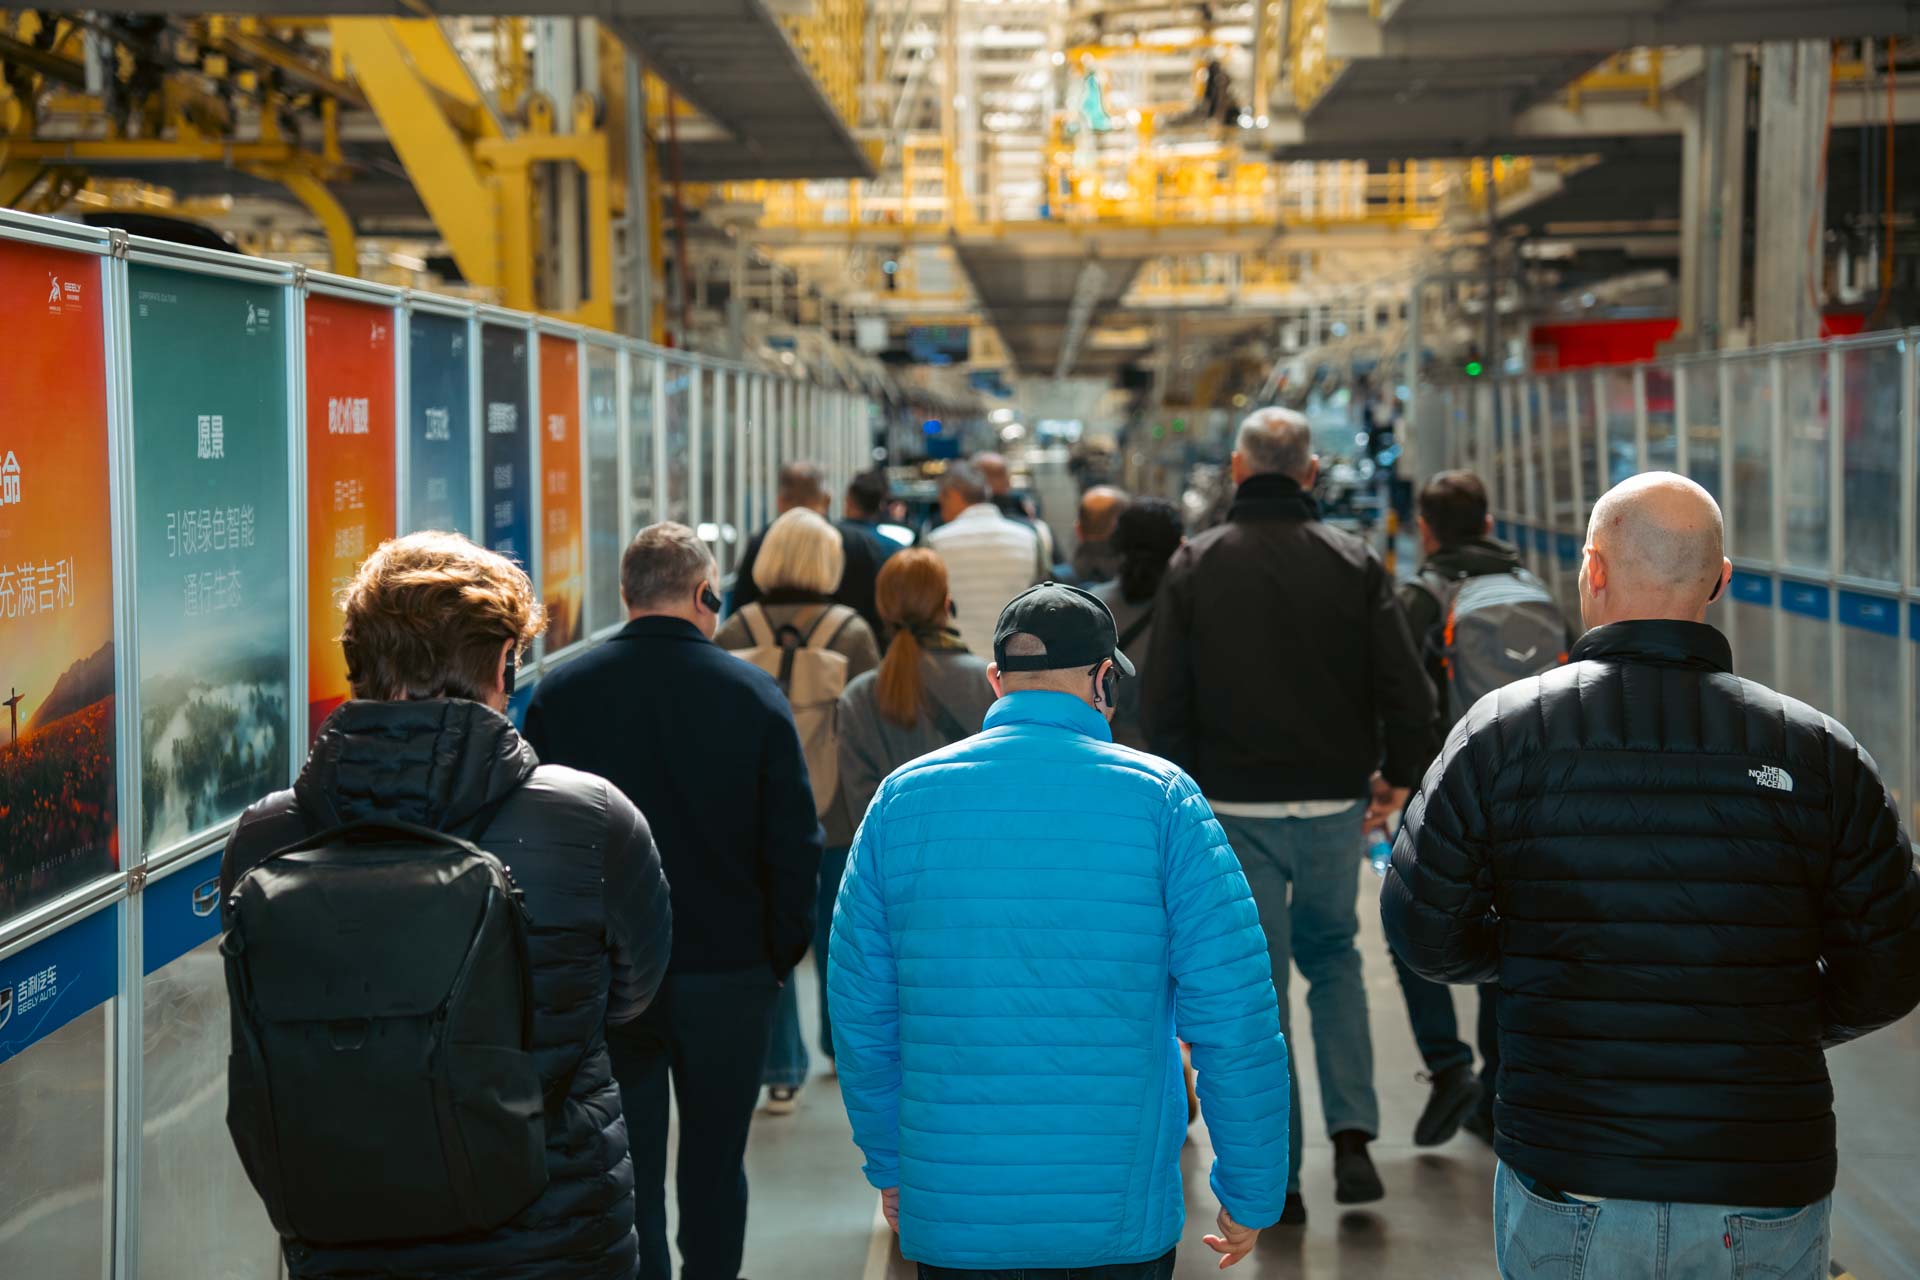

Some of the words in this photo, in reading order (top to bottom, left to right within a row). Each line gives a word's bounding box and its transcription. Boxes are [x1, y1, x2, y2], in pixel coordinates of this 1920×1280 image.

[198, 415, 224, 459] 愿景
[0, 450, 21, 506] 命
[166, 504, 255, 557] 引领绿色智能
[0, 556, 75, 618] 充满吉利
[1748, 769, 1779, 781] NORTH
[1756, 777, 1779, 789] FACE
[1762, 764, 1779, 774] THE
[18, 965, 57, 1003] 吉利汽车
[18, 995, 39, 1015] GEELY
[39, 985, 57, 1003] AUTO
